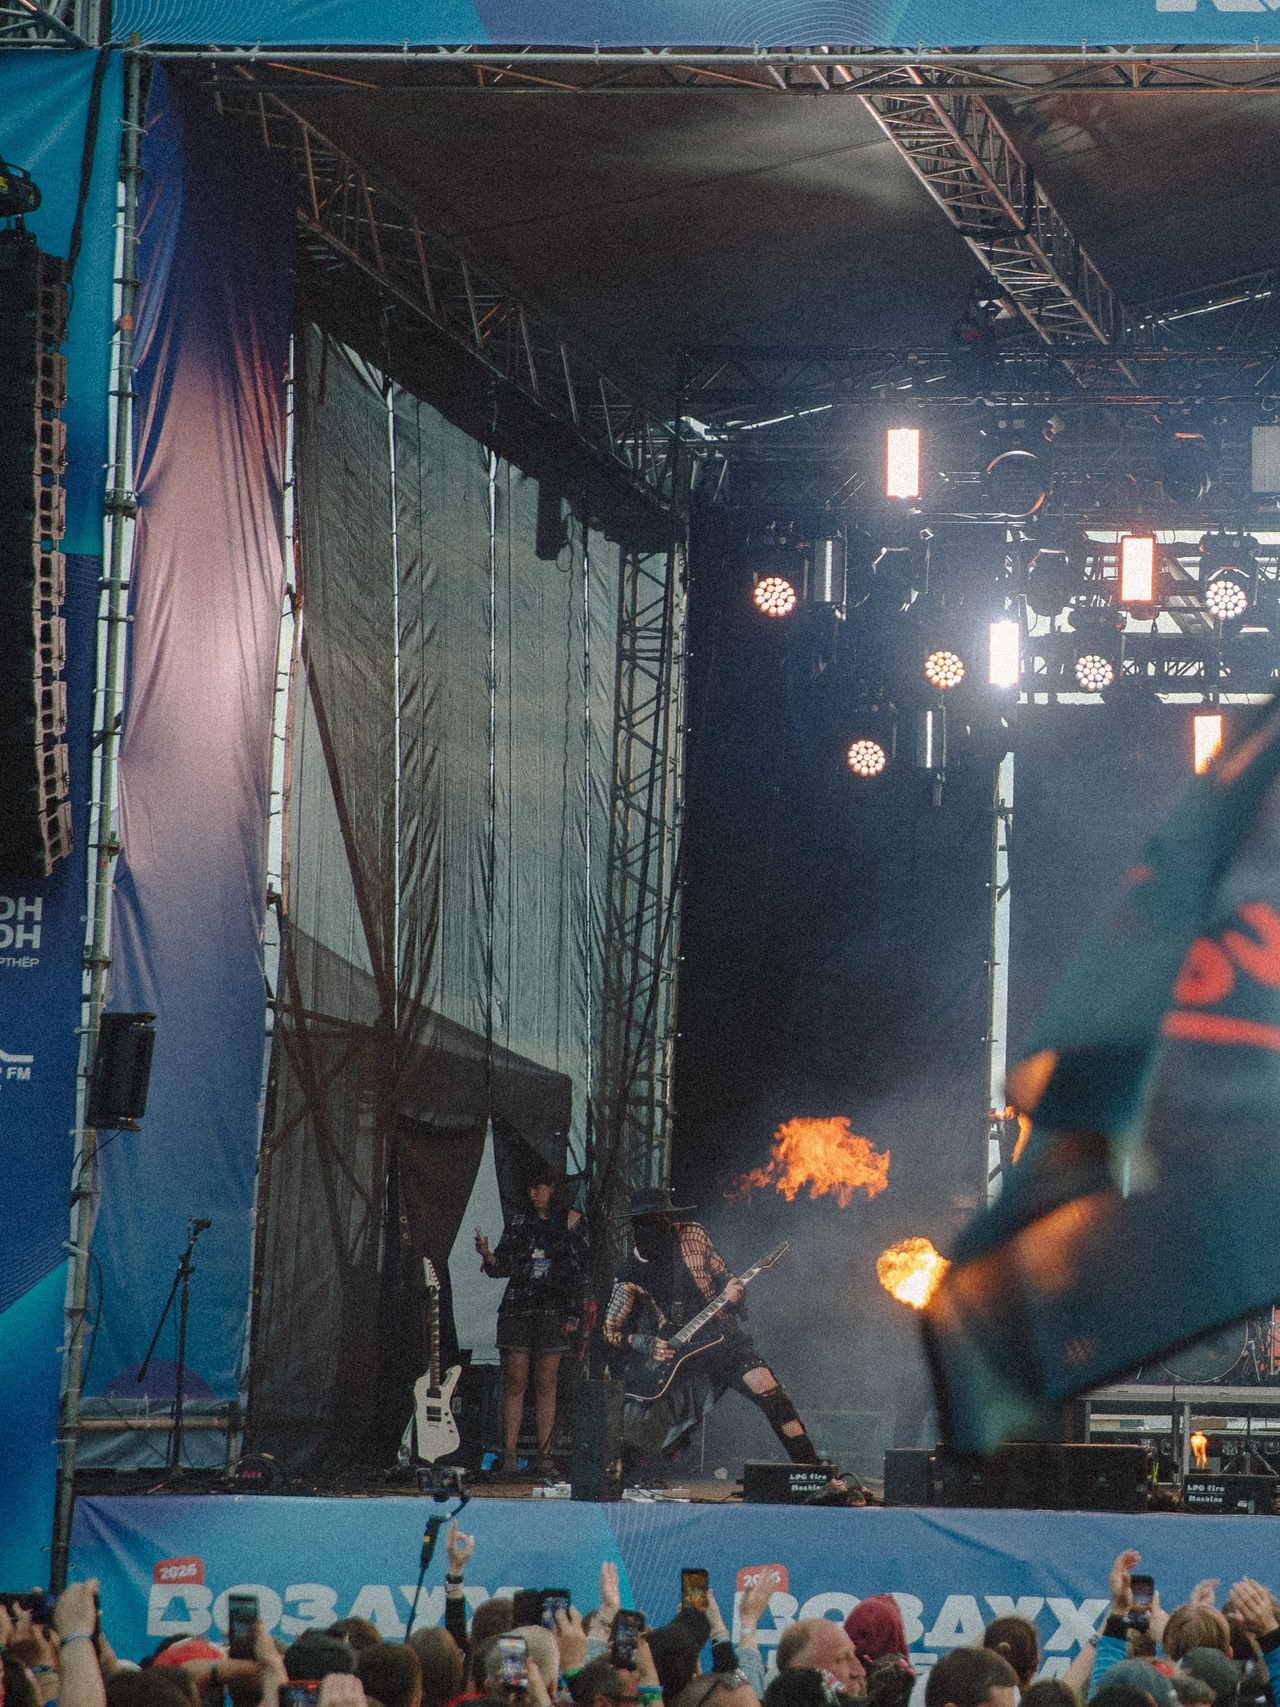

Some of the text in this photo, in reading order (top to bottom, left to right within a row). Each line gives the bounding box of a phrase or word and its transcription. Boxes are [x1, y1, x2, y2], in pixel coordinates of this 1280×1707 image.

[6, 1066, 31, 1080] FM
[1187, 1484, 1205, 1492] LPG
[159, 1563, 197, 1581] 2026
[743, 1570, 782, 1589] 206
